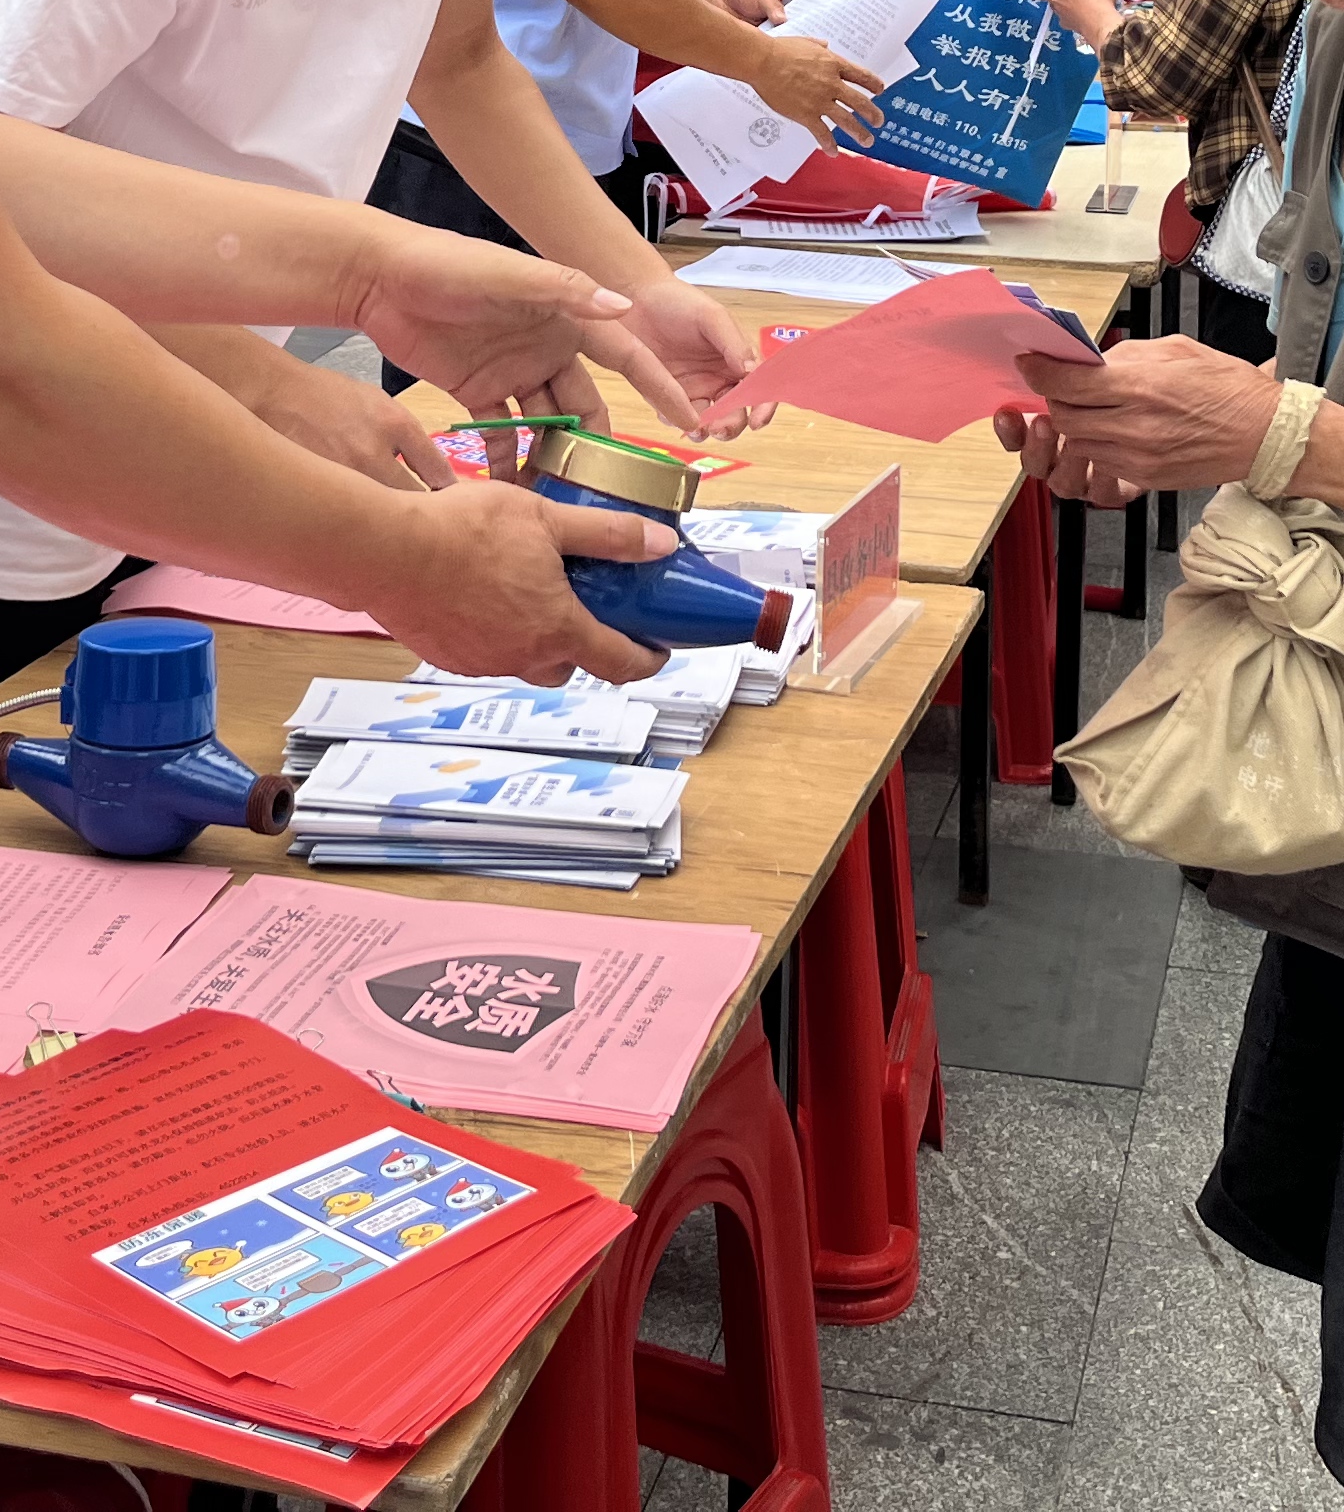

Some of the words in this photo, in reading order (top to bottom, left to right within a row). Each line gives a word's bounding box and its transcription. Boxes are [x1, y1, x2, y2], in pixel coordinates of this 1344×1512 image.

[931, 34, 1052, 86] 举报传销
[395, 959, 507, 1031] 安全
[459, 967, 569, 1039] 水质
